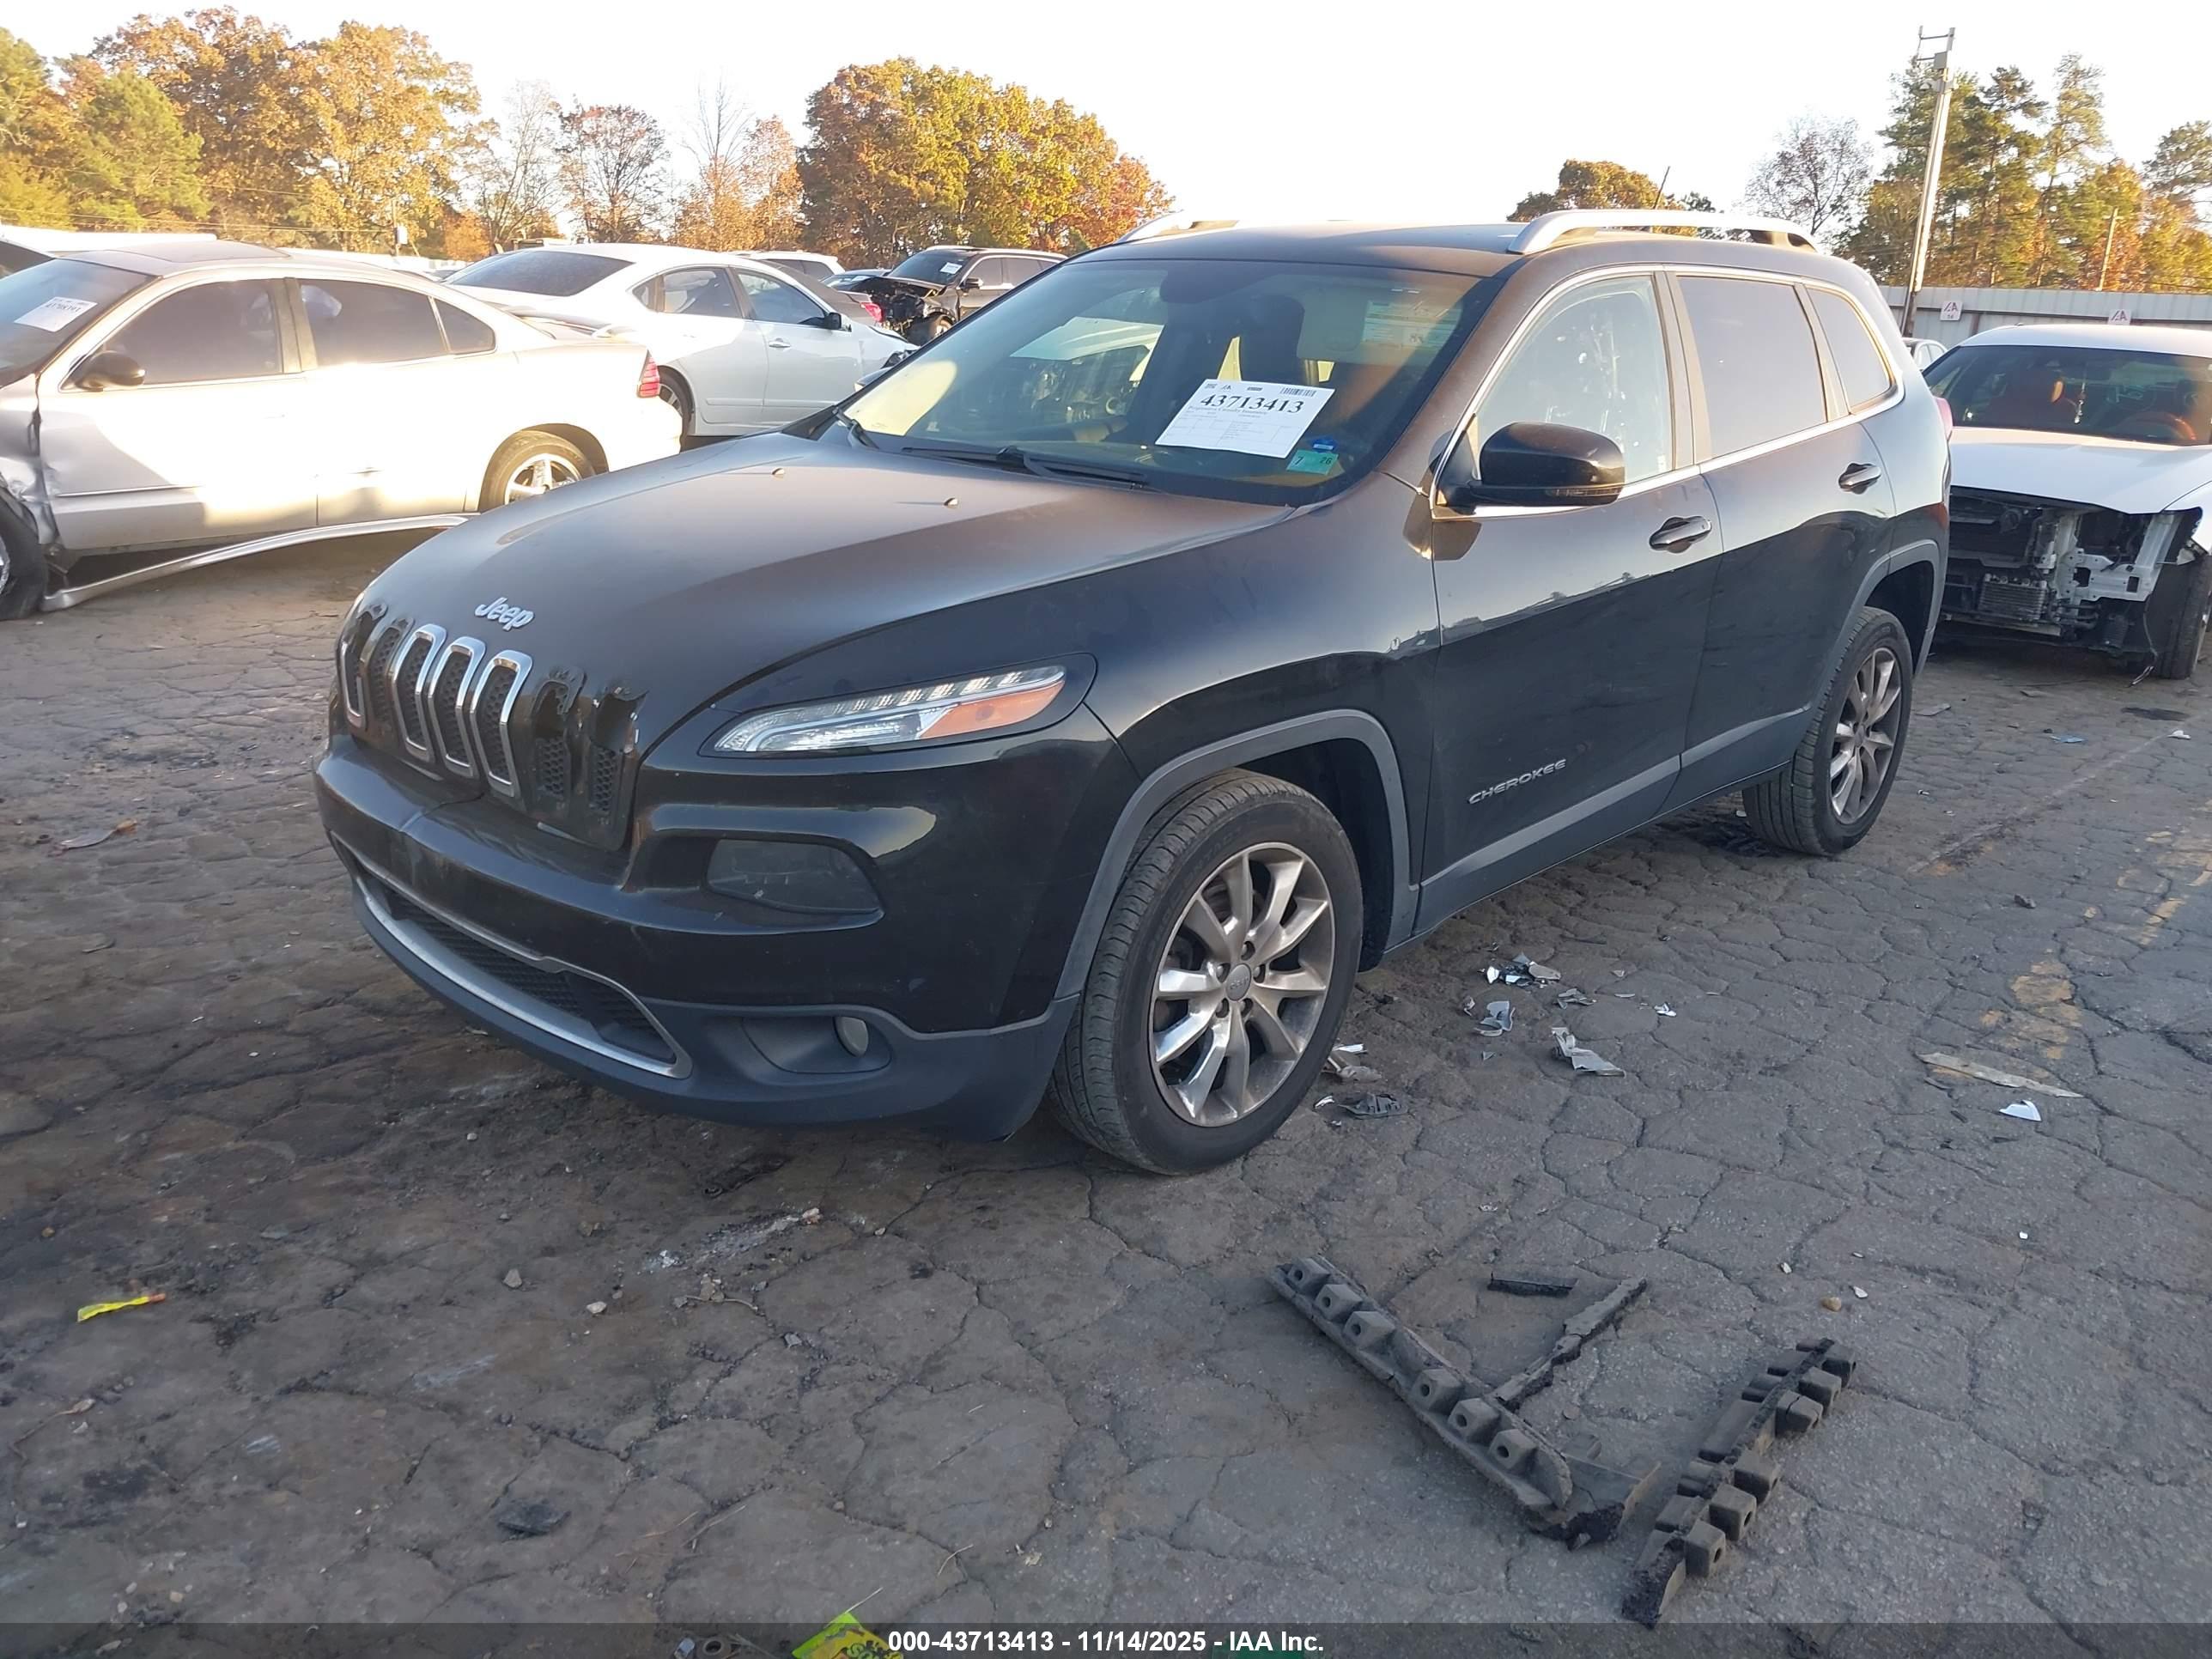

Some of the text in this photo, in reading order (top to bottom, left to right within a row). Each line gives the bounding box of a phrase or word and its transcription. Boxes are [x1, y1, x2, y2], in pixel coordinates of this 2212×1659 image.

[1200, 394, 1304, 414] 43713413
[1294, 456, 1304, 465] 7
[474, 597, 535, 631] Jeep
[1468, 758, 1567, 804] CHEROKEE
